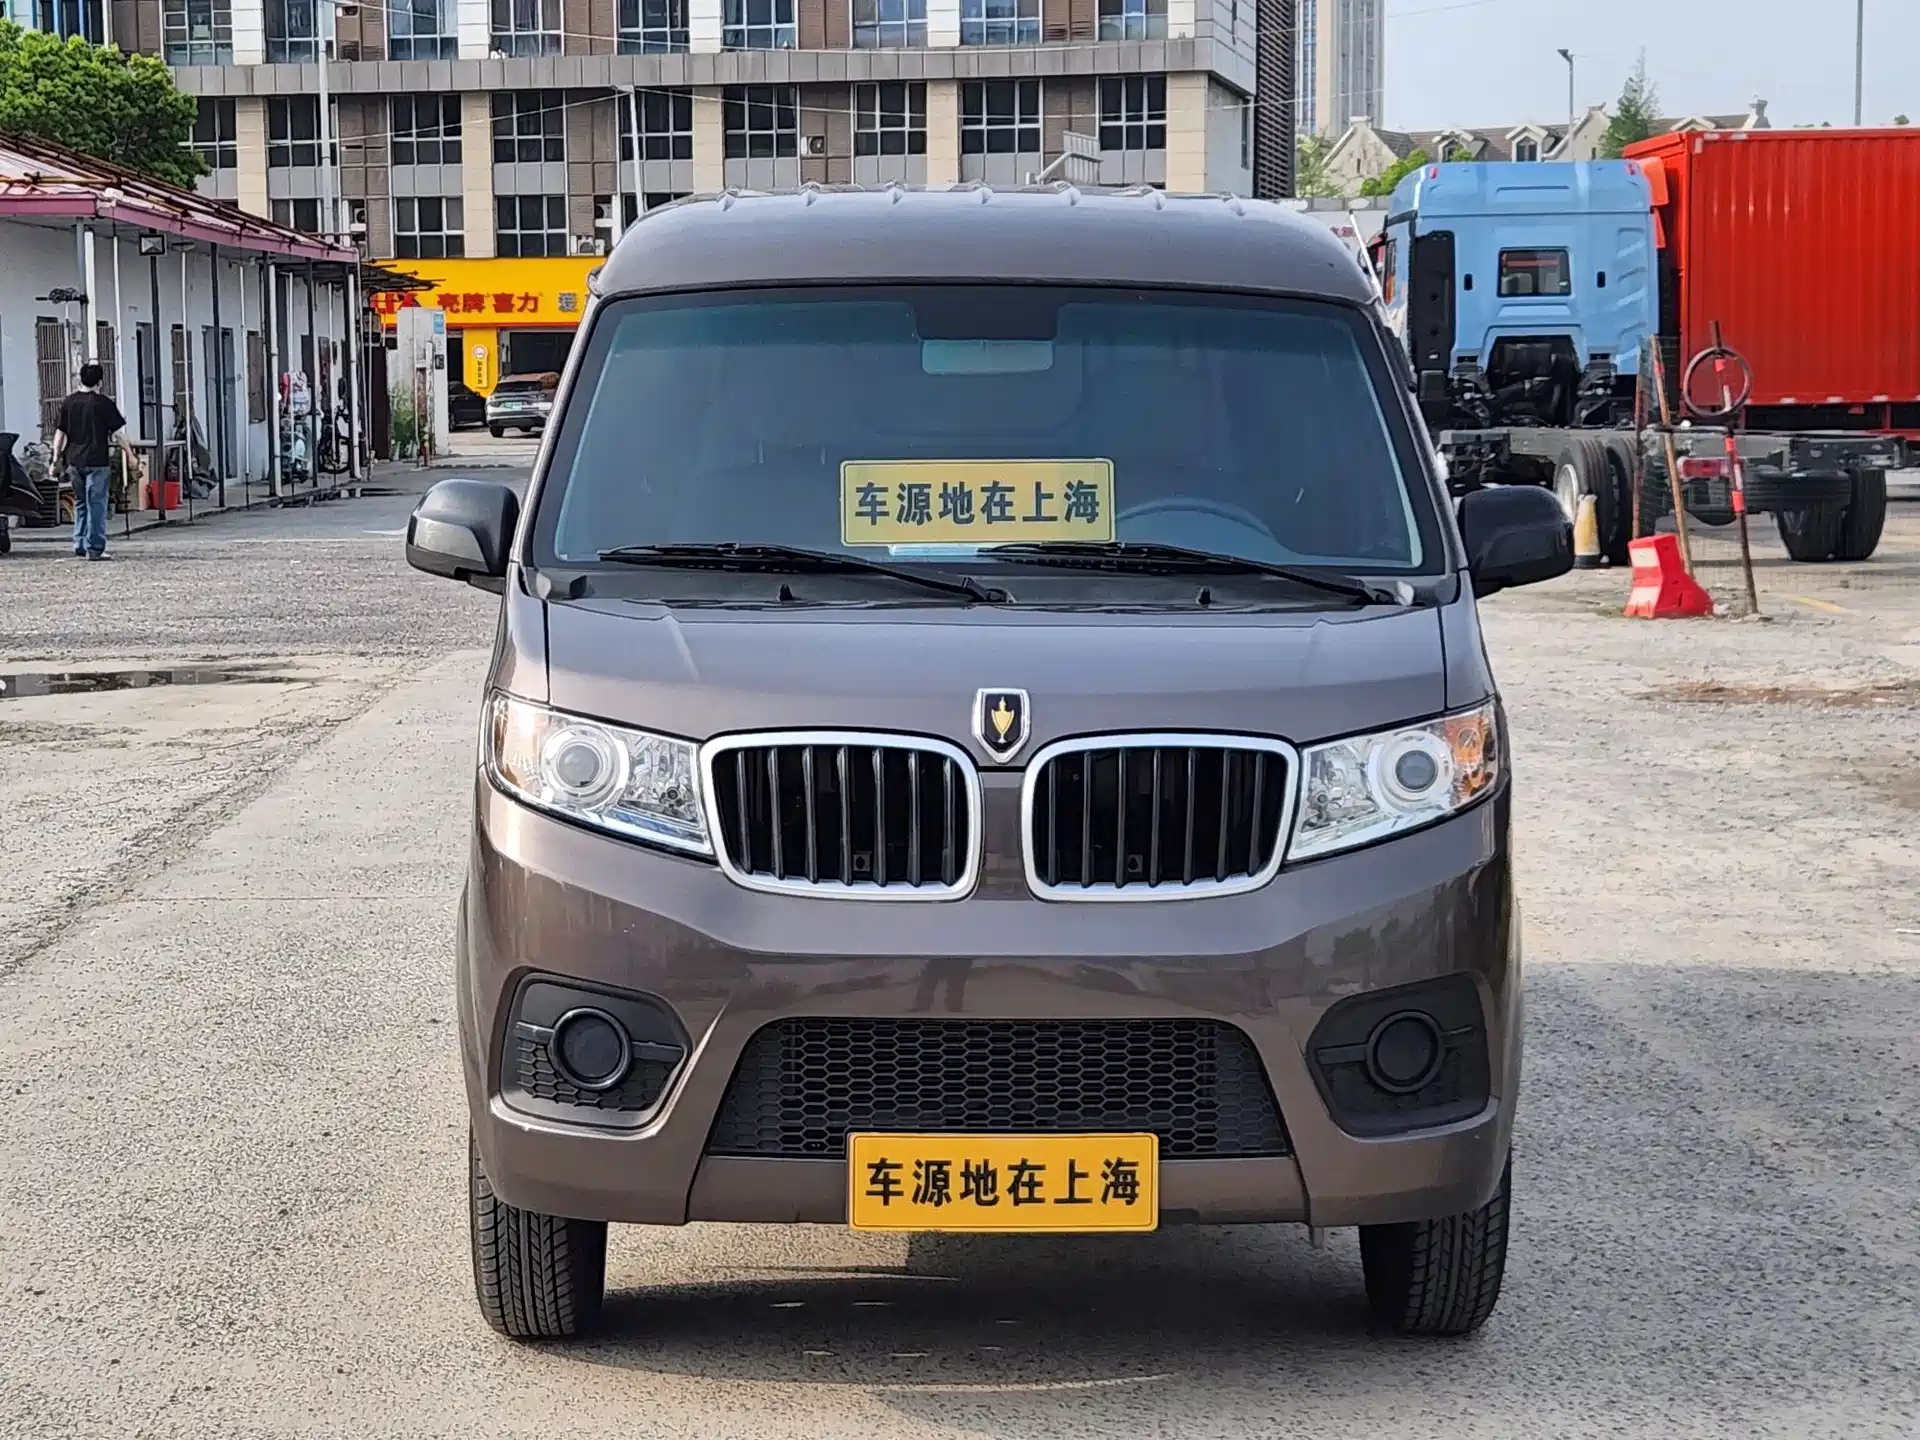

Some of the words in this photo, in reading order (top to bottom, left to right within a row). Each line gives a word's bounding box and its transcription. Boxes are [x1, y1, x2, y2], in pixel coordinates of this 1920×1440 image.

[855, 480, 1099, 526] 车源地在上海
[866, 1157, 1140, 1207] 车源地在上海
